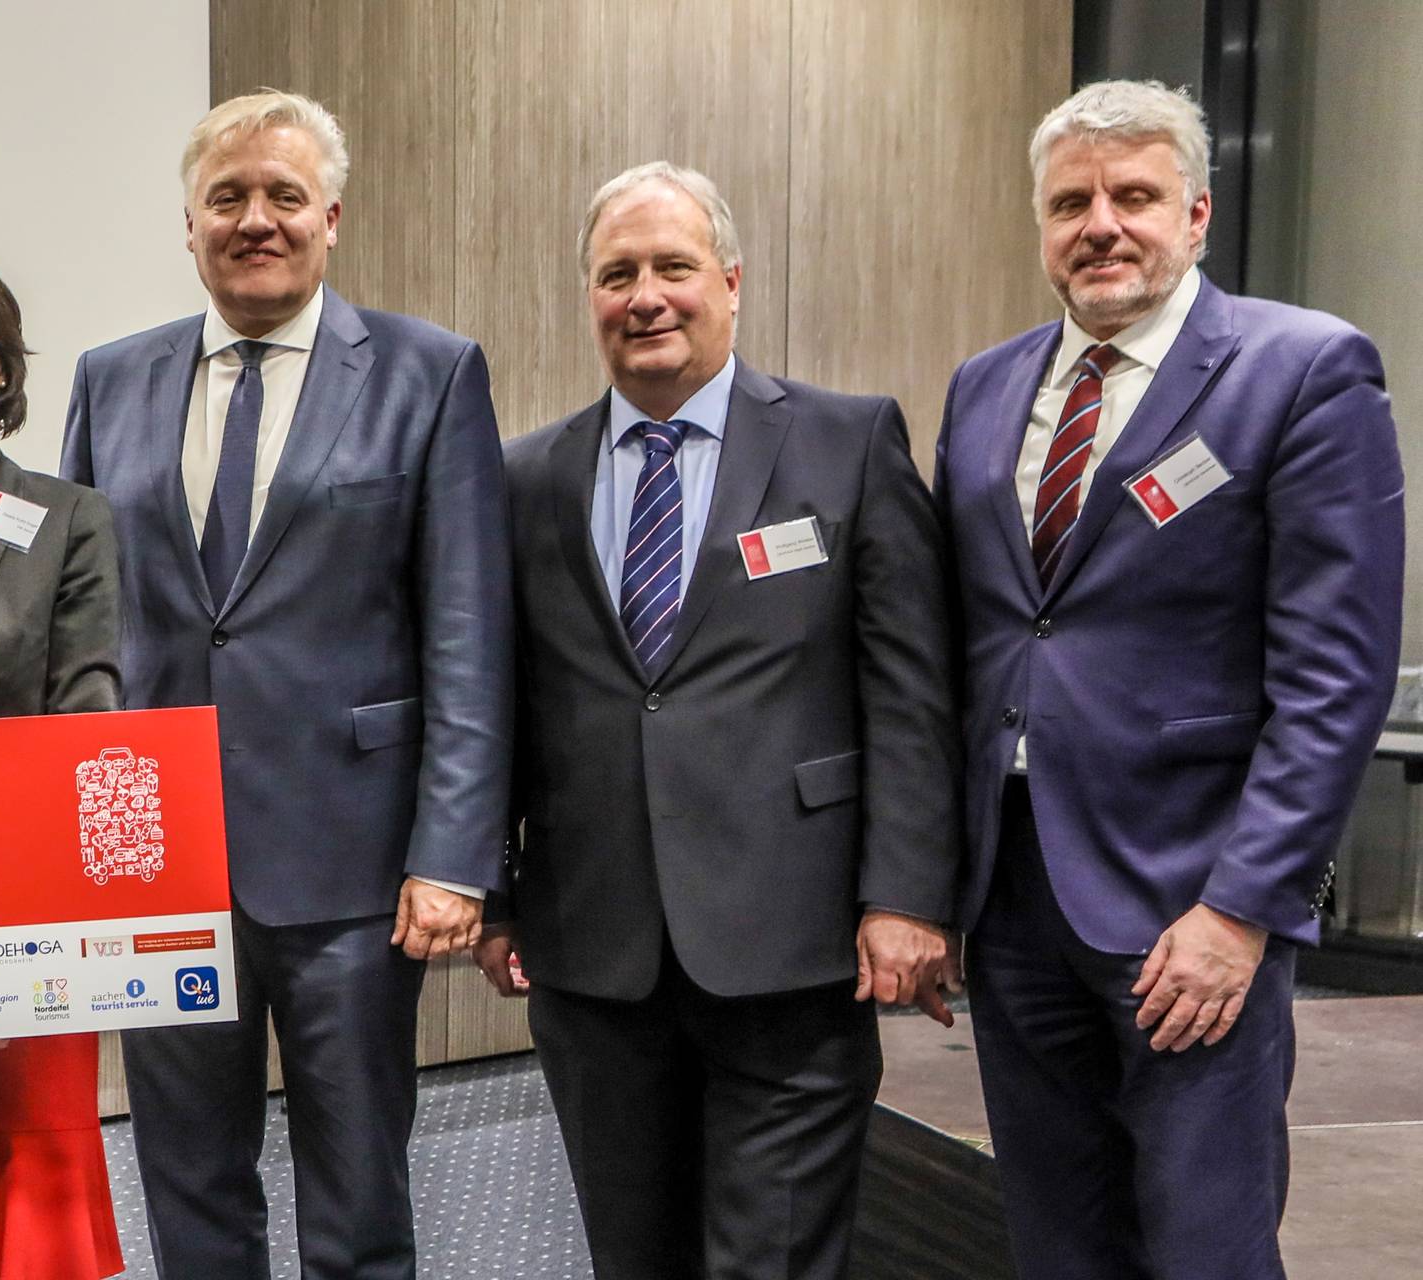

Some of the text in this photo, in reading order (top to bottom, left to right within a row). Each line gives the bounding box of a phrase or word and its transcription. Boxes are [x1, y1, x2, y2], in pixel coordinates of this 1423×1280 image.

[91, 991, 126, 1001] aachen
[34, 1004, 70, 1013] Nordeifel
[91, 998, 159, 1011] tourist service
[34, 1012, 70, 1021] Tourismus
